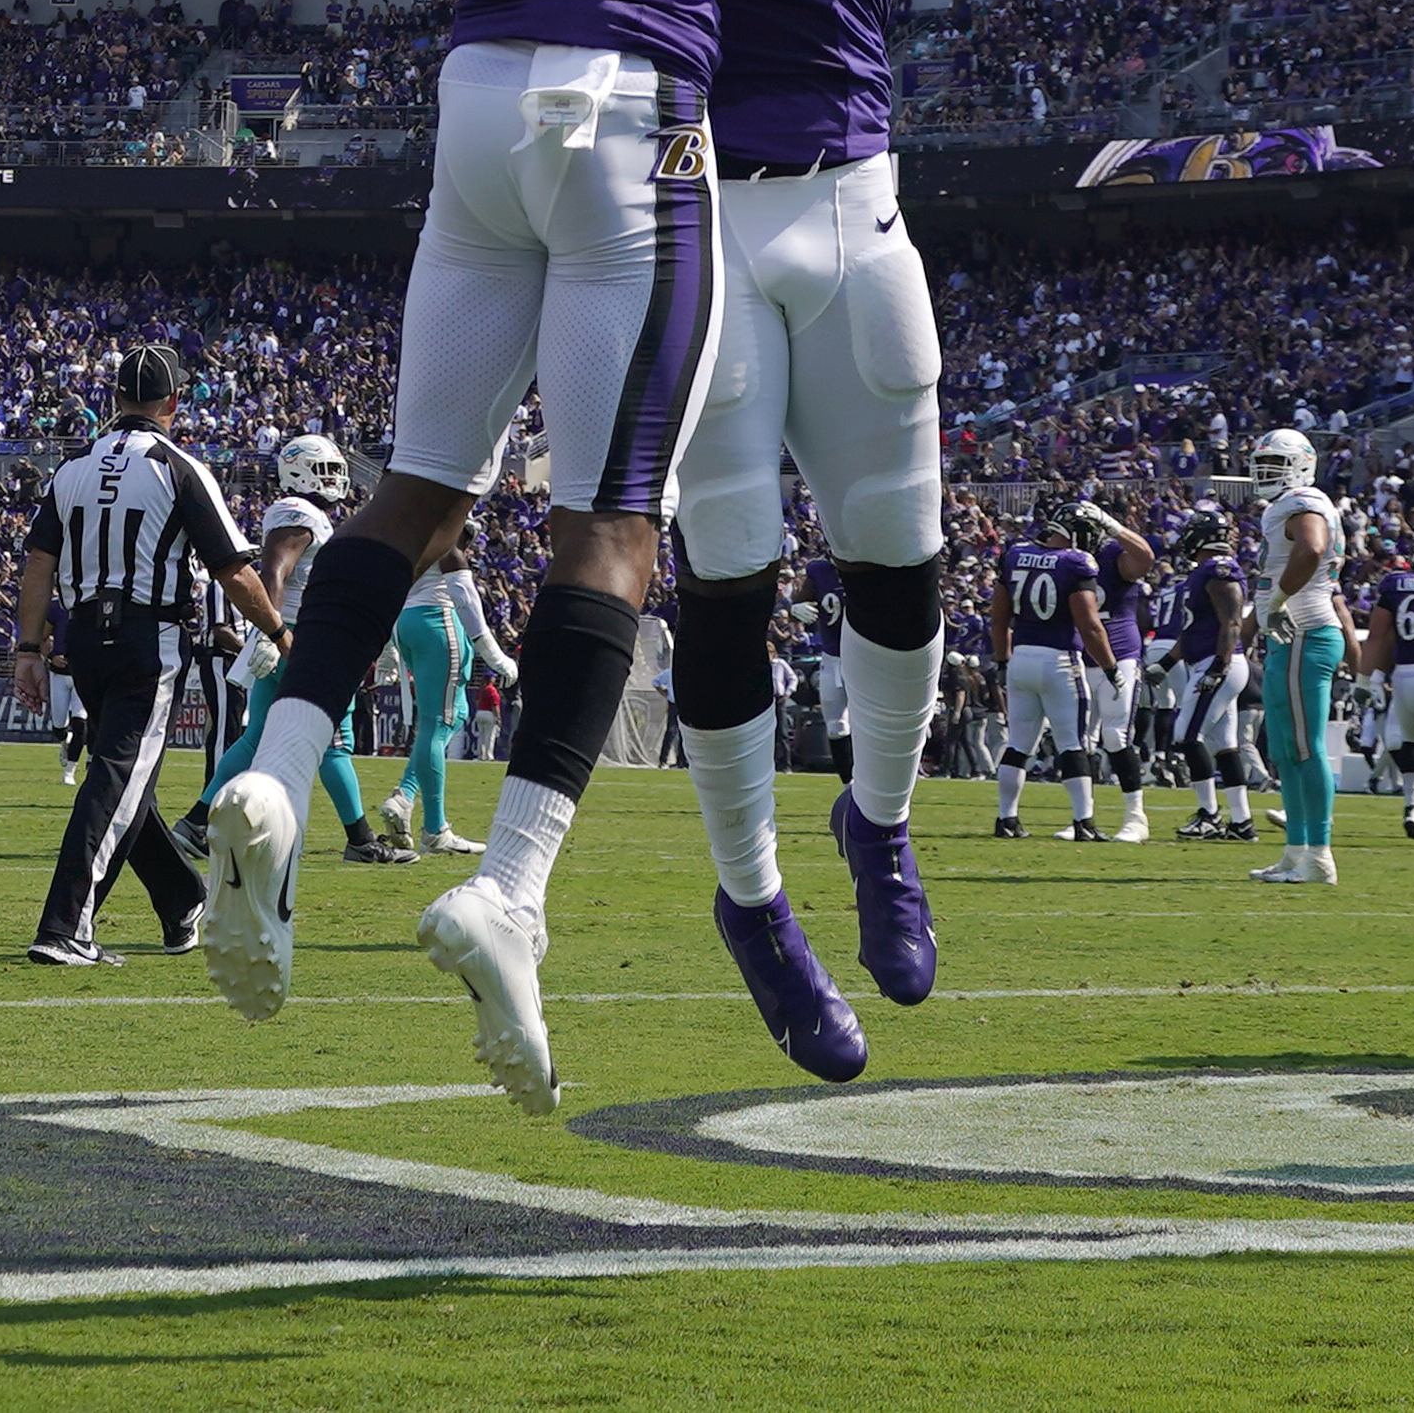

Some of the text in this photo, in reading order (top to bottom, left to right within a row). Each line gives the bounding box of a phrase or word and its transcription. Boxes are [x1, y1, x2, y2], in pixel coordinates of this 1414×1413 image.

[99, 456, 130, 473] SJ
[97, 475, 123, 505] 5
[1009, 570, 1058, 621] 70
